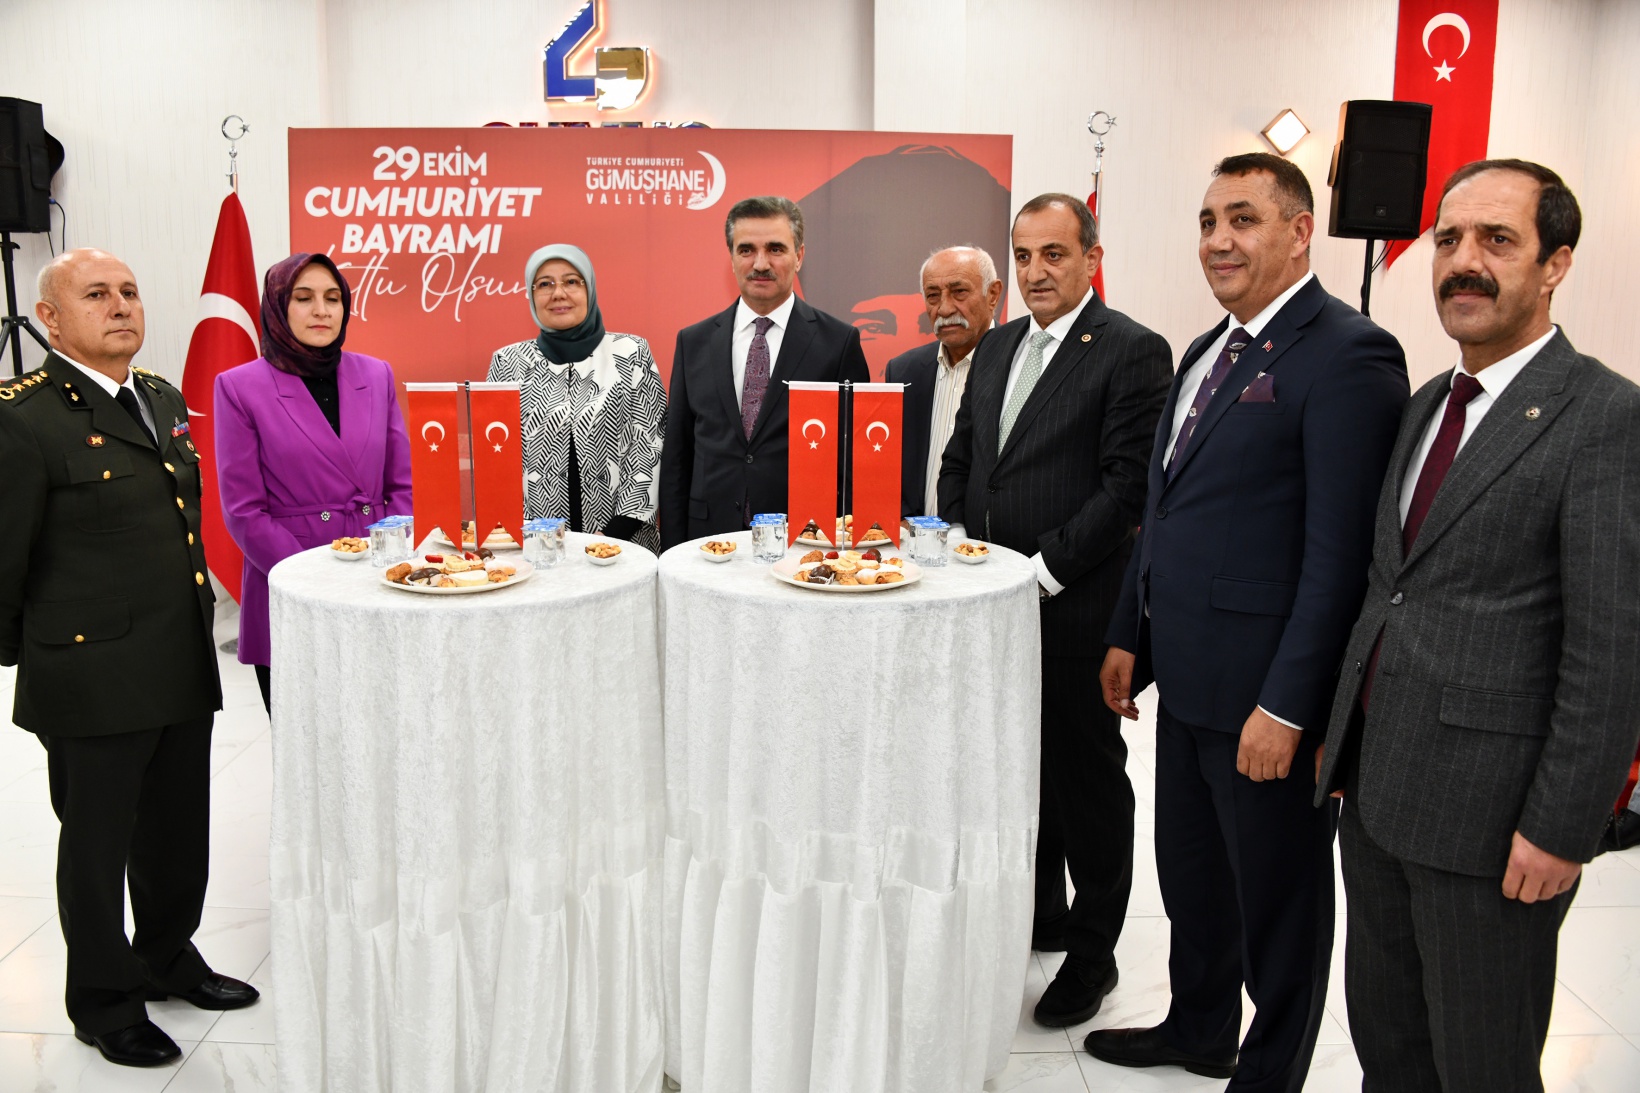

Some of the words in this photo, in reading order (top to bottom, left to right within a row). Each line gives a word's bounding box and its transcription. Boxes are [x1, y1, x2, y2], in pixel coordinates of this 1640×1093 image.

[372, 146, 420, 181] 29
[423, 145, 487, 176] EKİM
[304, 177, 542, 217] CUMHURİYET
[586, 168, 705, 194] GÜMÜŞHANE
[341, 224, 503, 254] BAYRAMI
